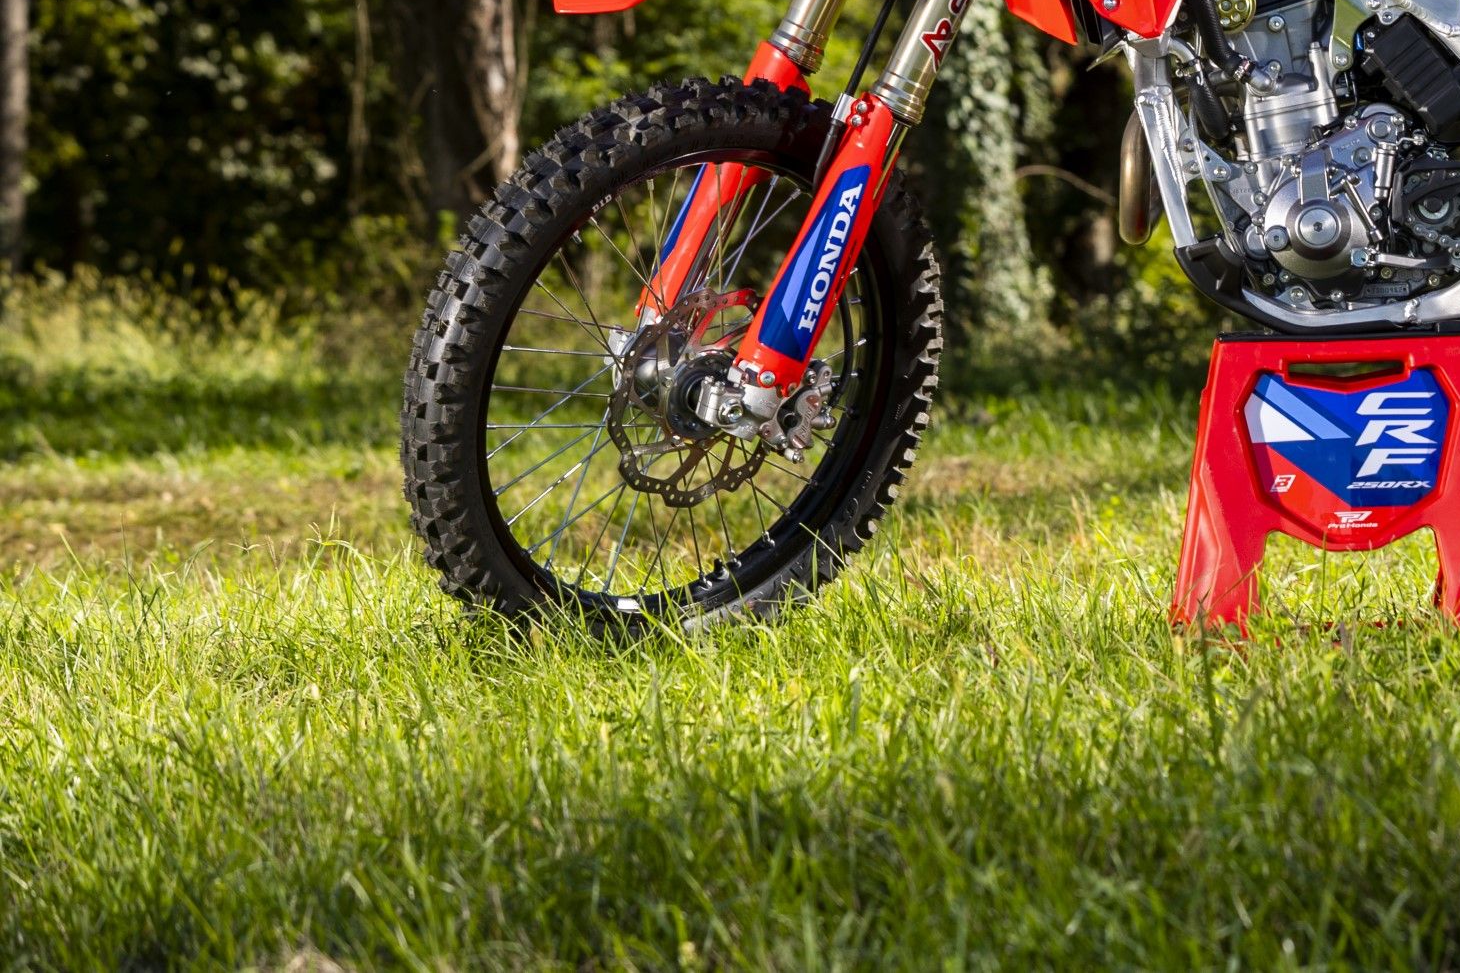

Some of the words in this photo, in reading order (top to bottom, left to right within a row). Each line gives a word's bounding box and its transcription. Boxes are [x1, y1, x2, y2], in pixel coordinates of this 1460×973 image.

[798, 183, 864, 334] HONDA
[1355, 392, 1438, 478] CRF
[1346, 480, 1432, 489] 250RX
